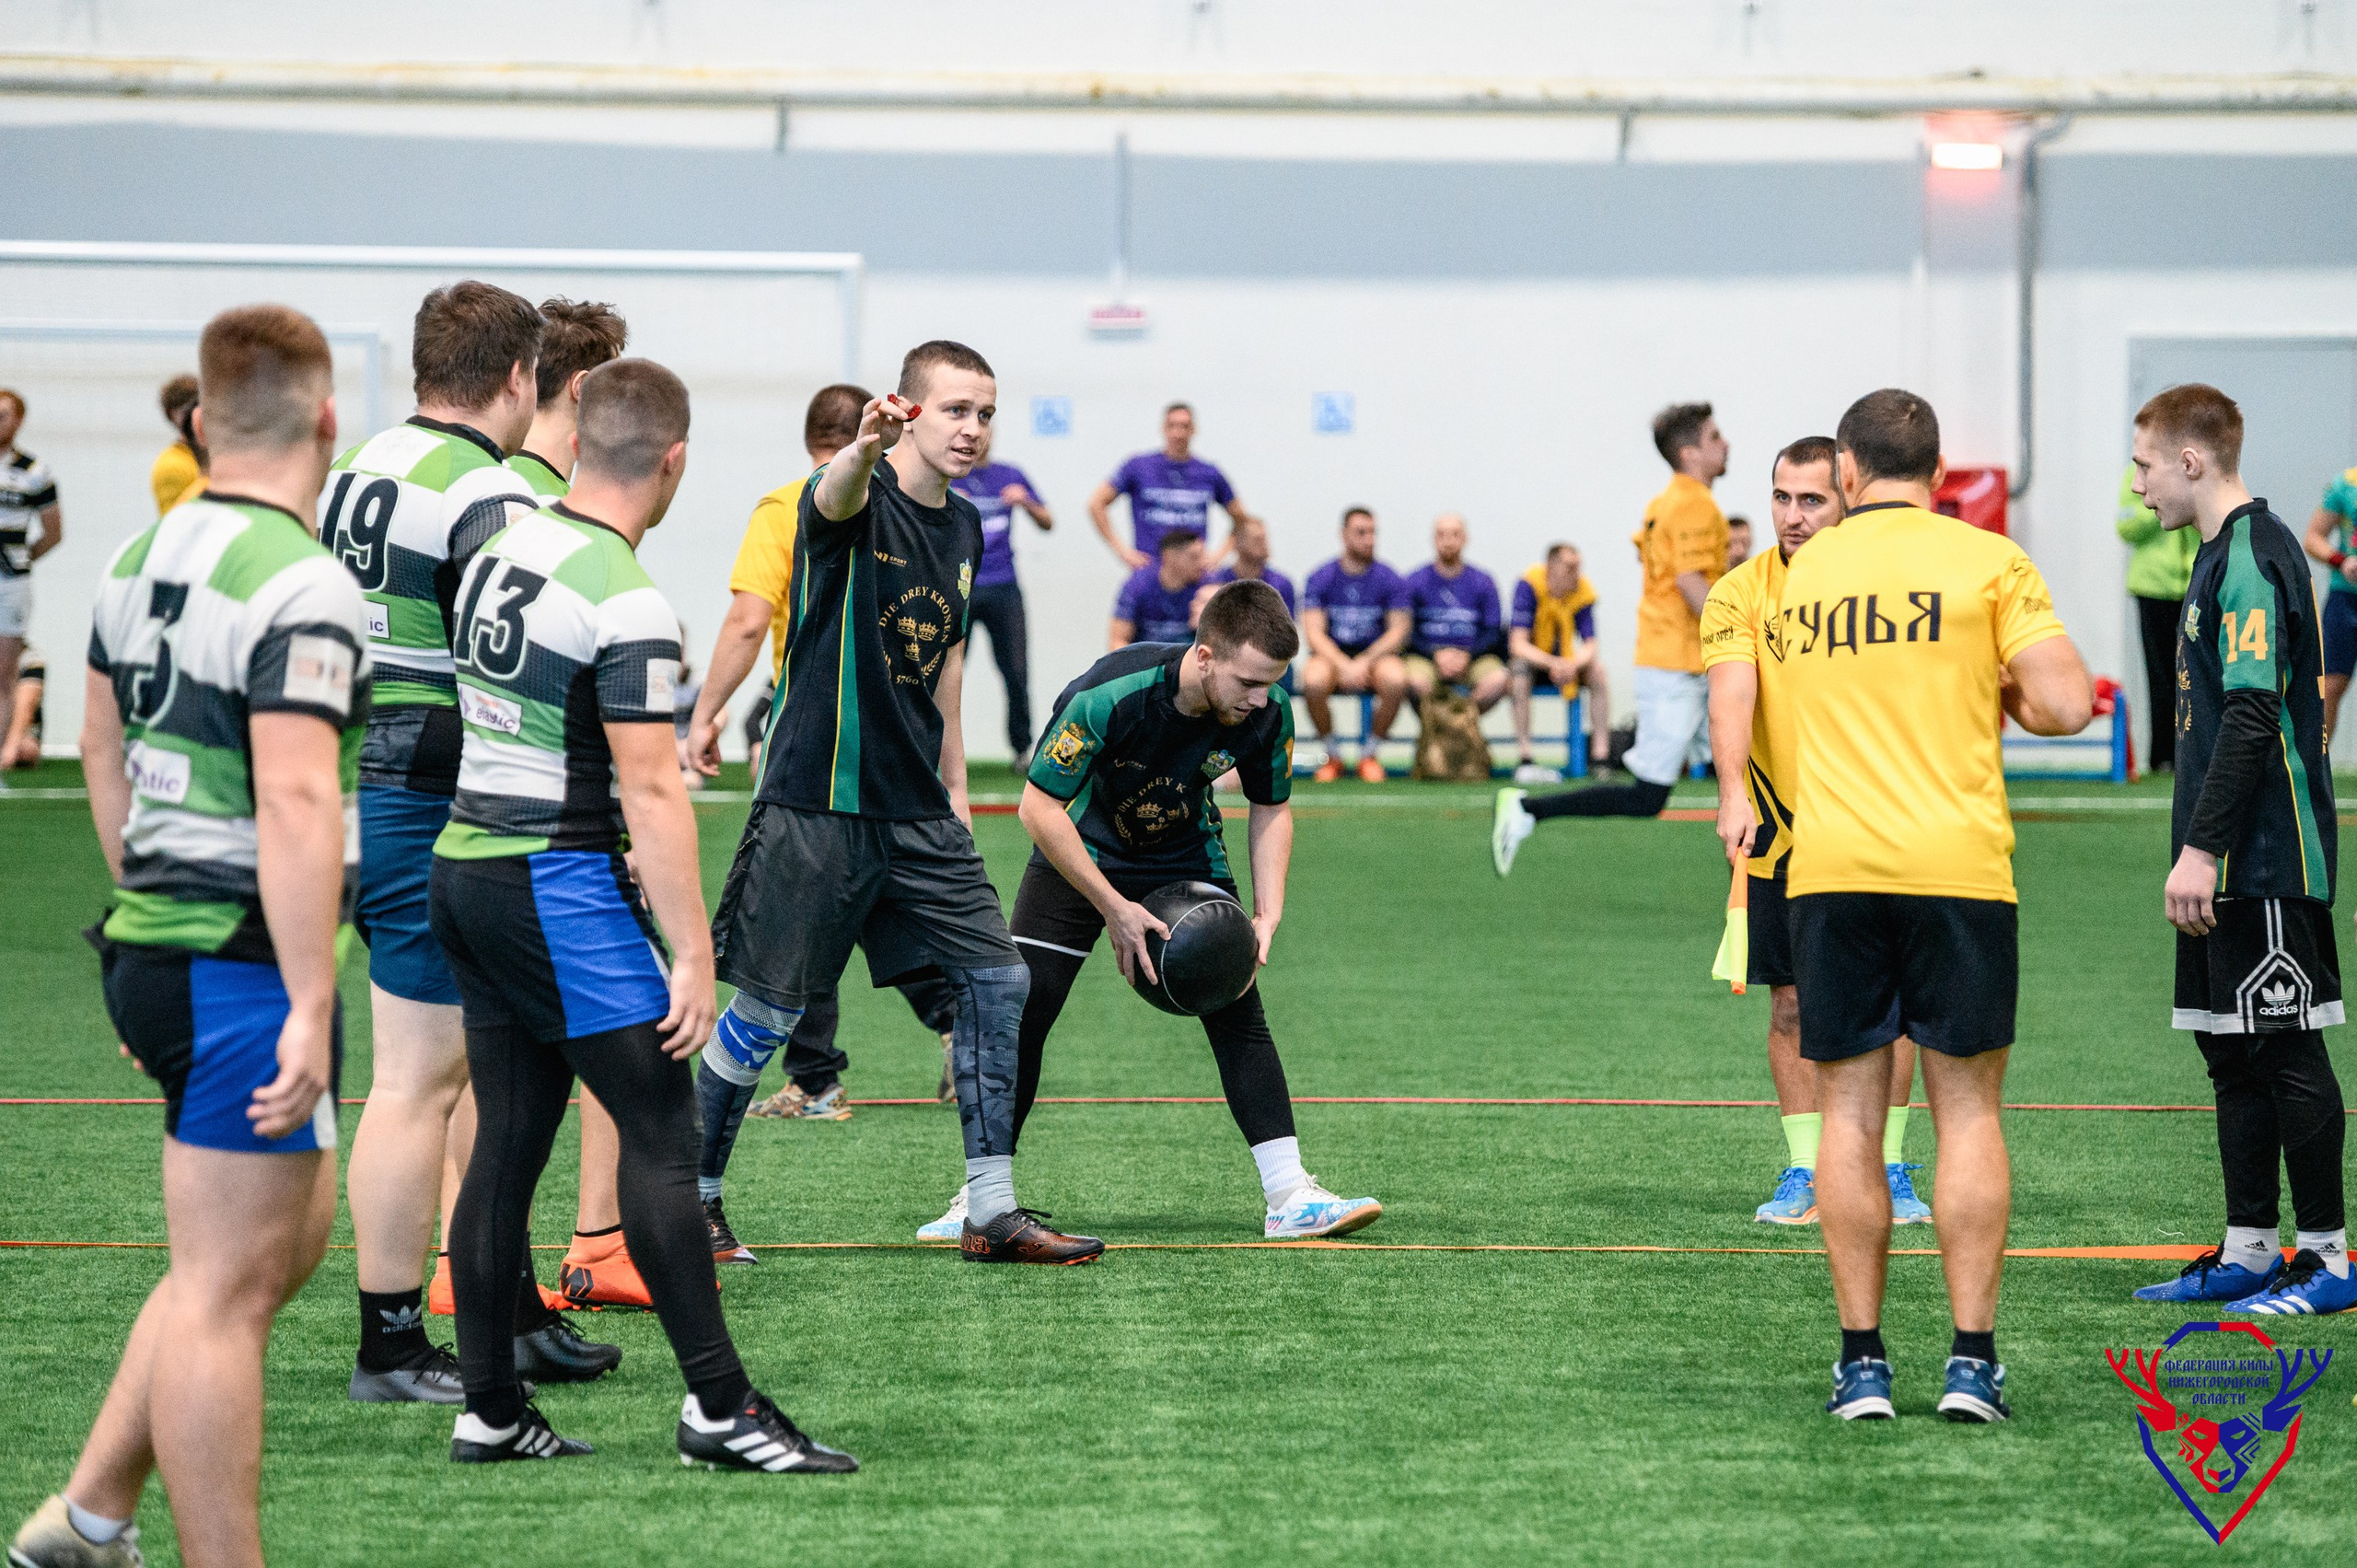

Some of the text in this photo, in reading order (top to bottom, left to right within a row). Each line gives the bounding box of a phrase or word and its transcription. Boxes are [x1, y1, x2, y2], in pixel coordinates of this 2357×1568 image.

[319, 470, 401, 592] 19
[454, 553, 550, 678] 13
[879, 586, 953, 643] DIE DREY KRONEN
[1779, 590, 1942, 661] СУДЬЯ
[2222, 609, 2269, 665] 14
[2258, 1005, 2299, 1016] adidas
